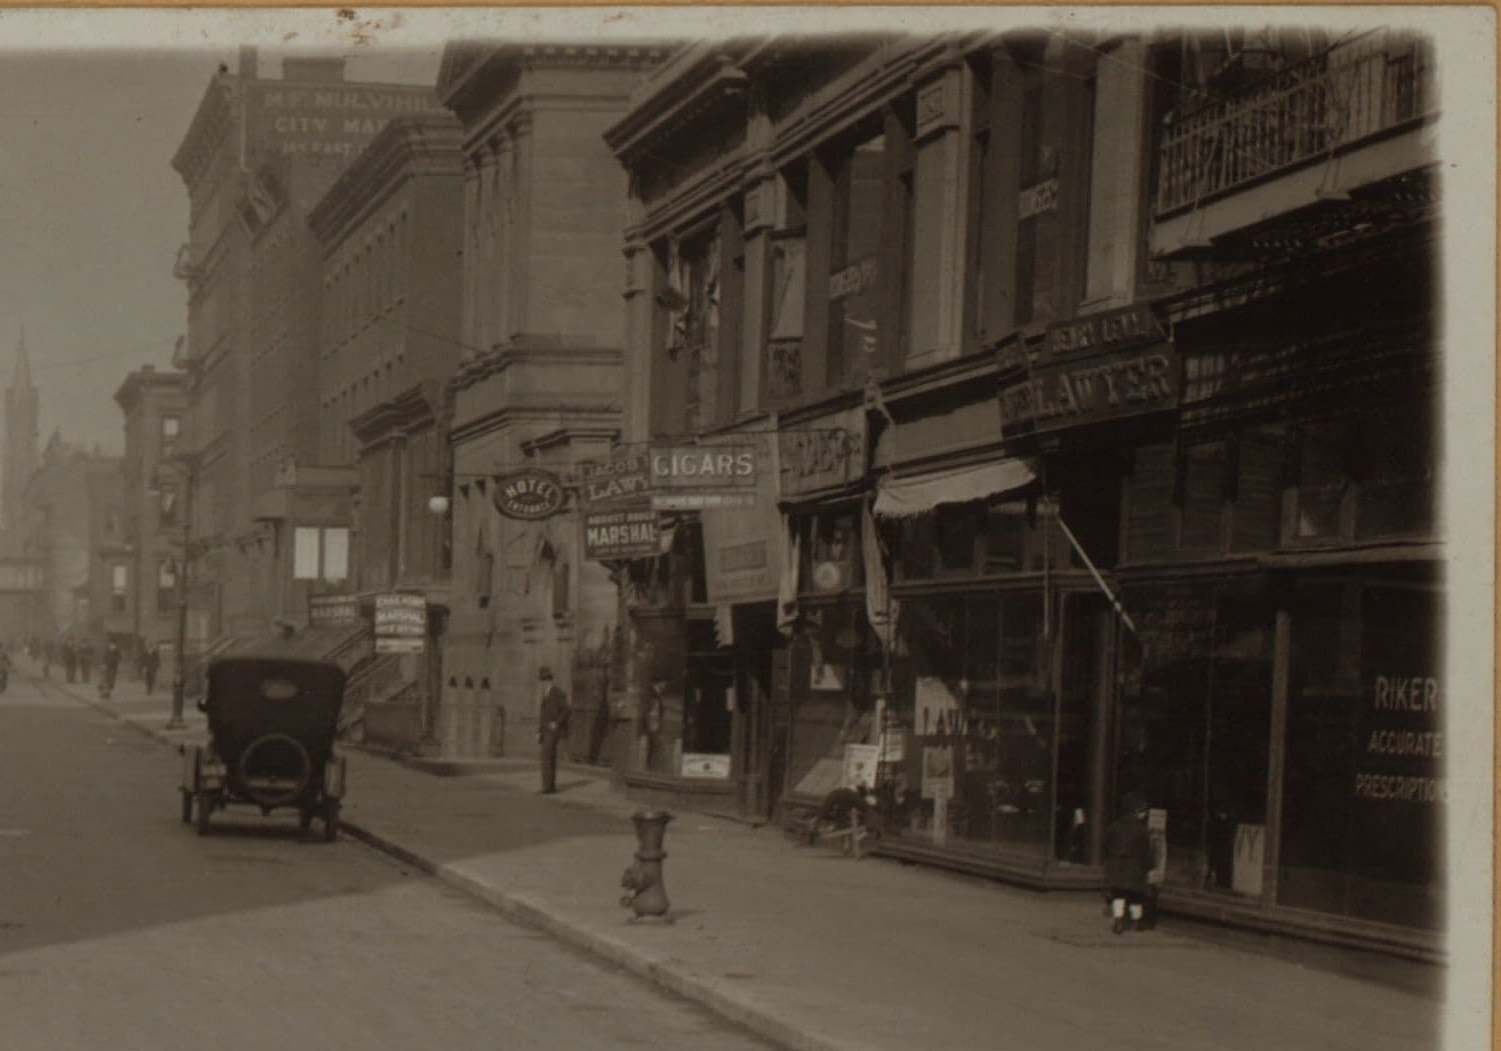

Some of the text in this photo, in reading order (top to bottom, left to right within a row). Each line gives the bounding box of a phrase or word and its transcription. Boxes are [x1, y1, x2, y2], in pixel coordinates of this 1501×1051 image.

[274, 116, 327, 133] CITY
[1033, 354, 1171, 415] LAWYER
[653, 453, 754, 477] CIGARS
[505, 479, 555, 499] HOTEL
[587, 523, 658, 546] MARSHAL
[1367, 729, 1444, 757] ACCURATE
